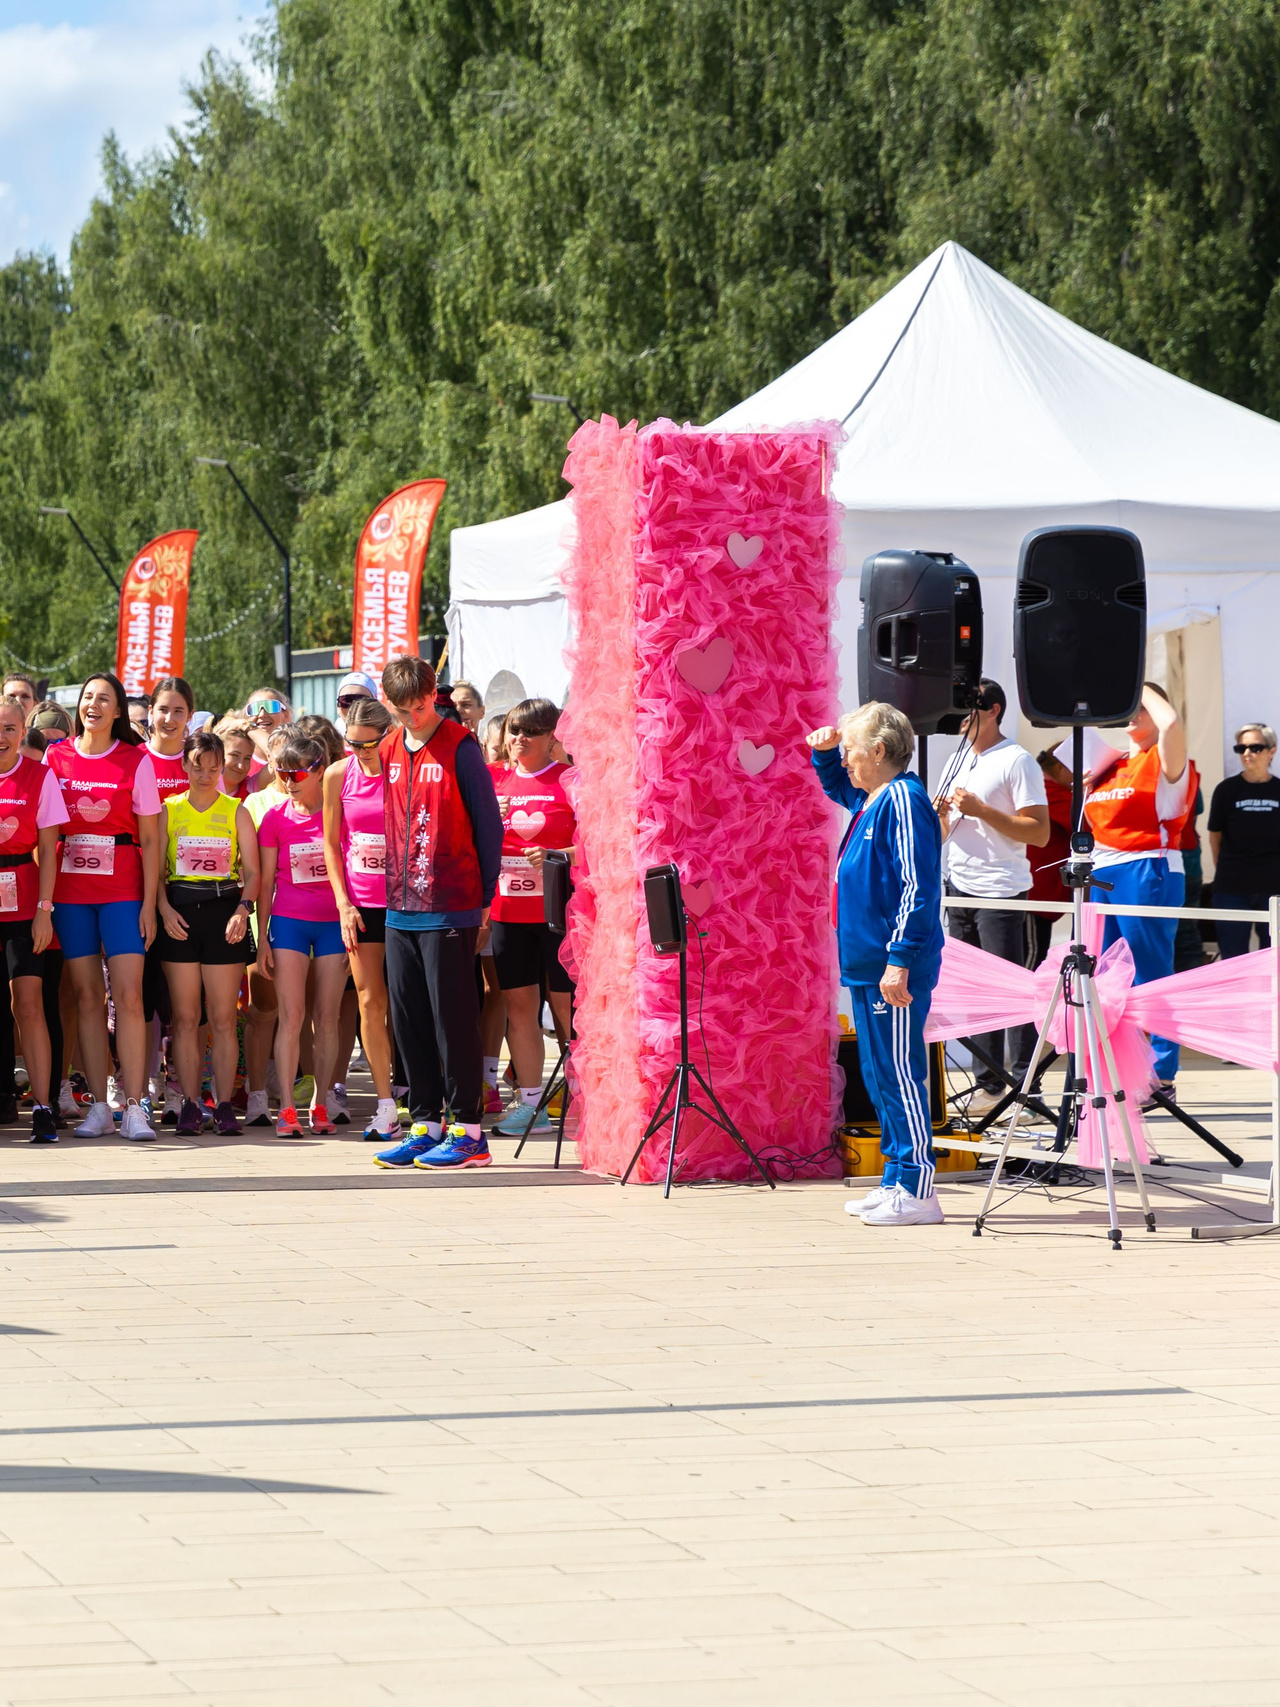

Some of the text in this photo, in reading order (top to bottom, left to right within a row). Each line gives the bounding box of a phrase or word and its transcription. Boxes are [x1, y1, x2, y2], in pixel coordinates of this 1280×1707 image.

[150, 604, 174, 681] ТУМАЕВ
[71, 780, 118, 789] КАЛАШНИКОВ
[73, 856, 101, 869] 99
[190, 859, 218, 871] 78
[510, 879, 536, 891] 59
